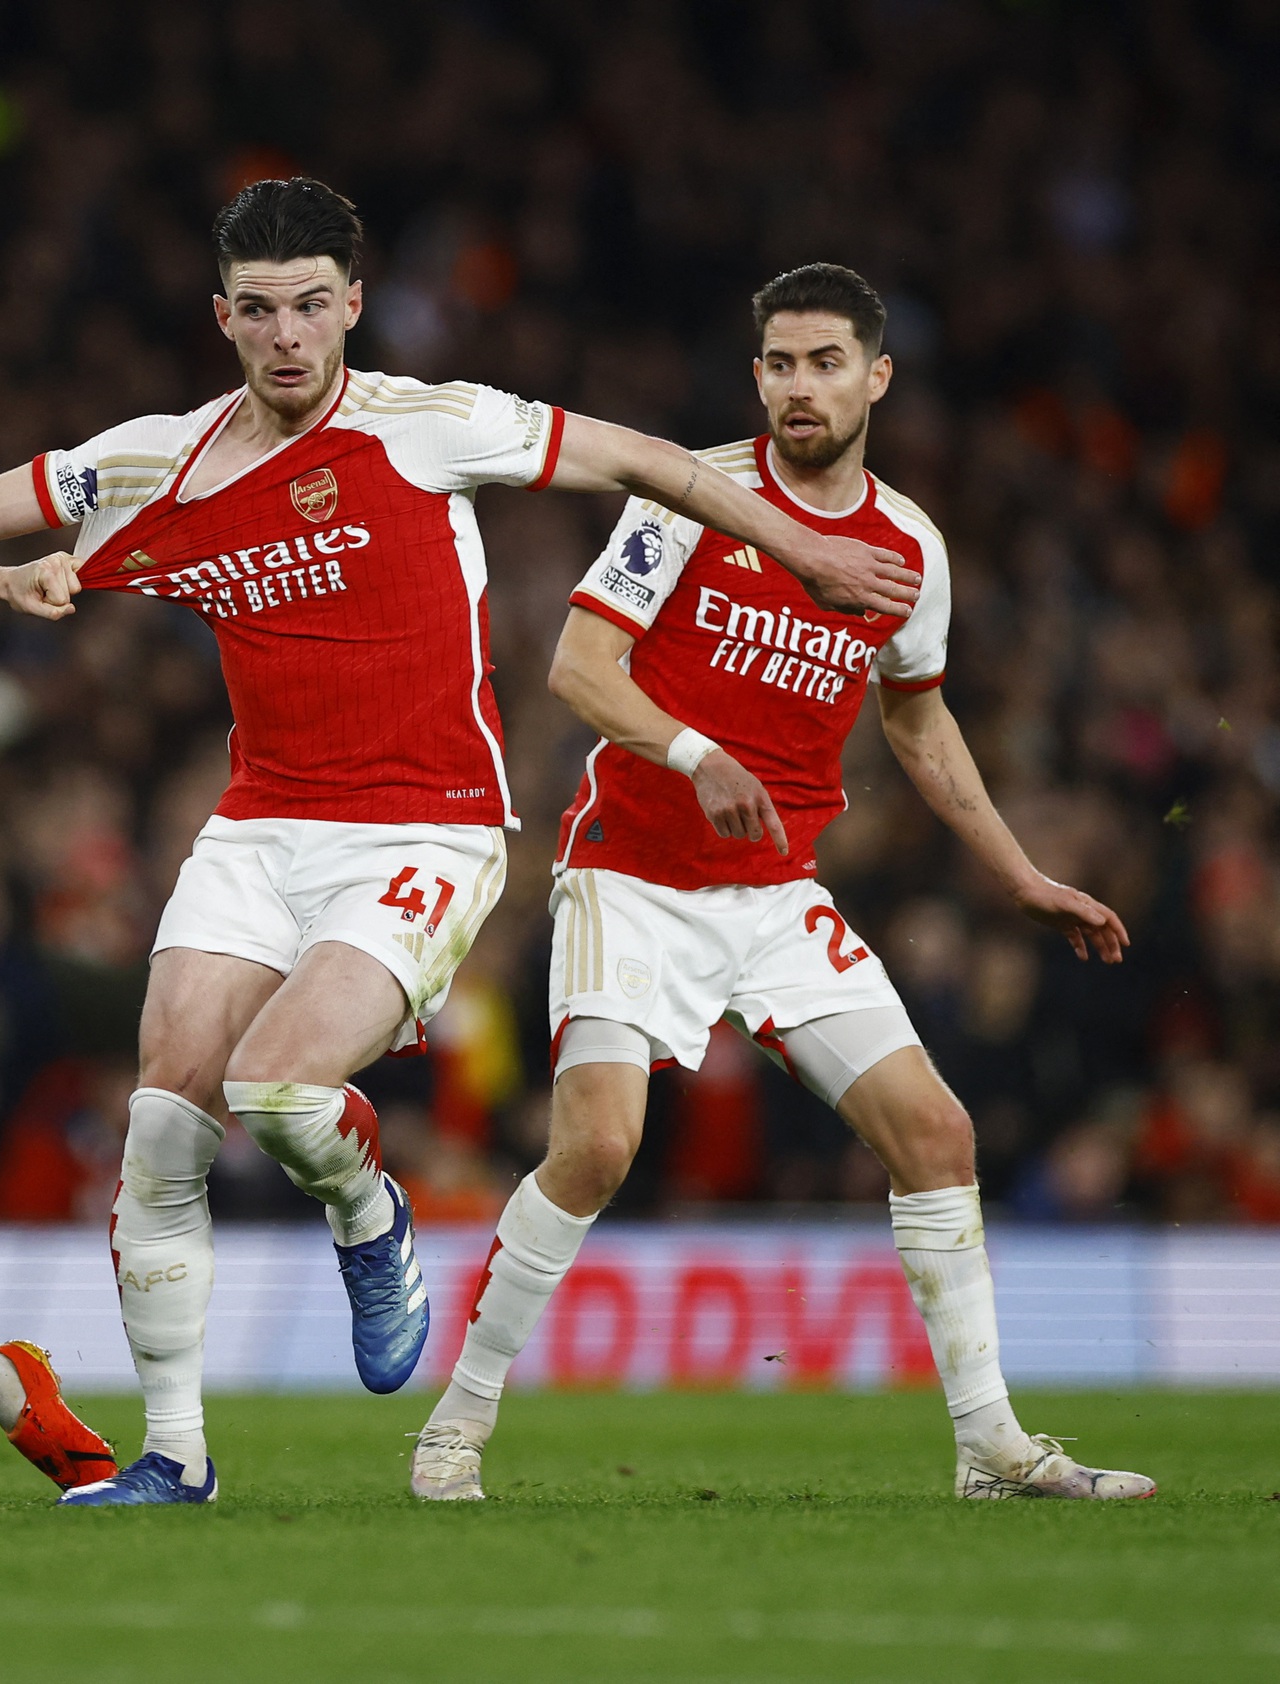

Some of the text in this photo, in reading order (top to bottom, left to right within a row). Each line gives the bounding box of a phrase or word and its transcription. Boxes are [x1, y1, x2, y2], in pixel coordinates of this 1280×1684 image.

[297, 476, 328, 494] Arsenal
[242, 559, 347, 613] BETTER
[600, 566, 649, 599] No room
[612, 583, 649, 610] racism
[709, 638, 846, 705] FLY BETTER
[445, 787, 485, 799] HEAT.RDY
[377, 866, 455, 938] 41
[123, 1262, 187, 1293] AFC
